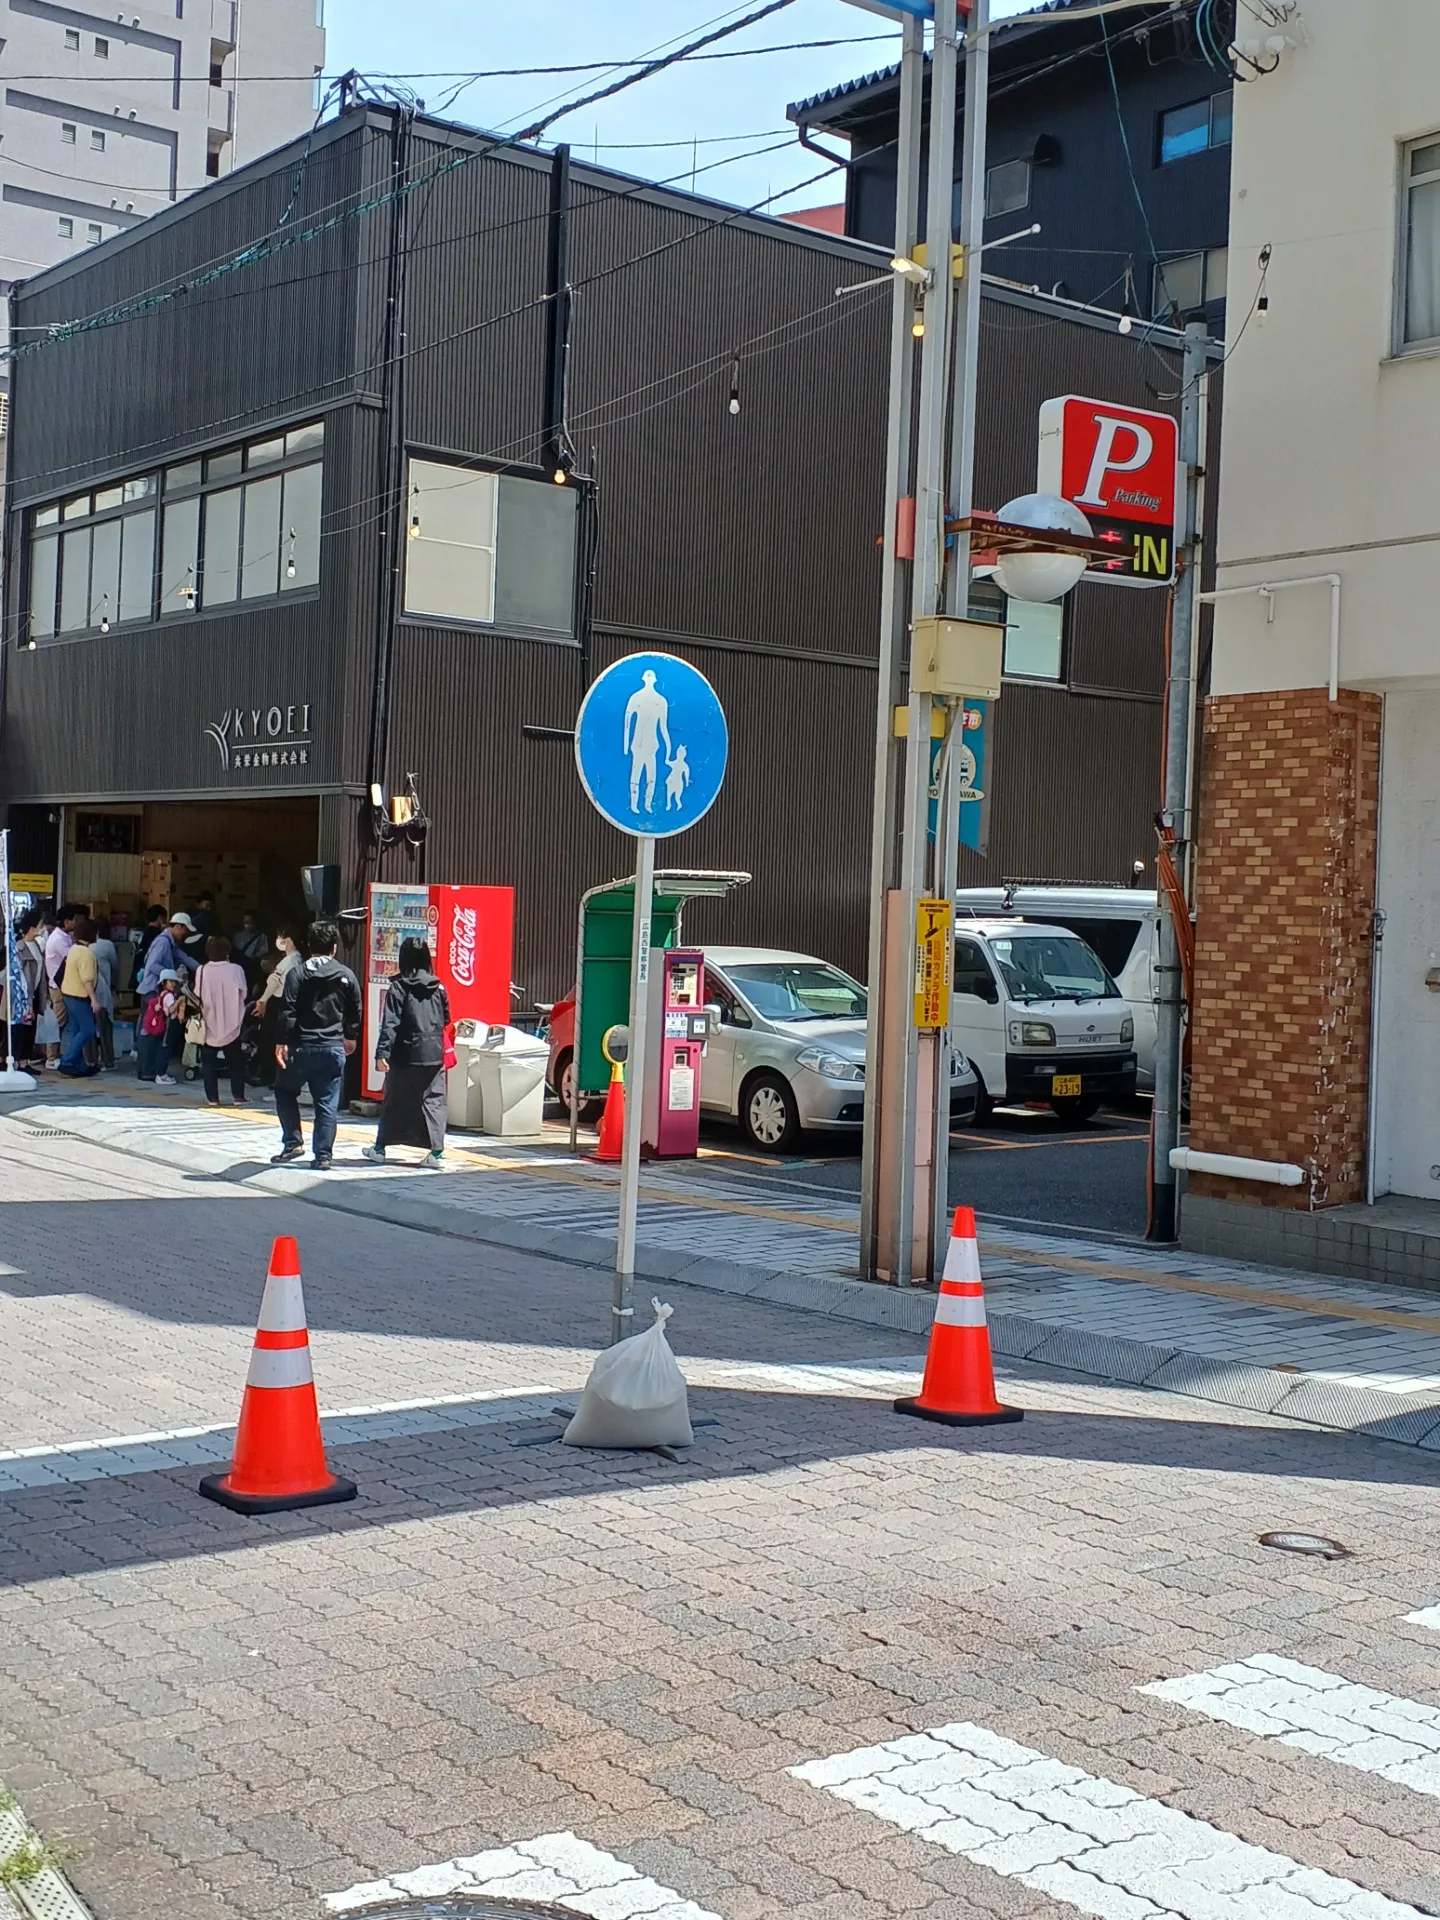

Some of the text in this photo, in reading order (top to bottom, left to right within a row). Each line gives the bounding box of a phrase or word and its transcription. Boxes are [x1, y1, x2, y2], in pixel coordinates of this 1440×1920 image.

[1072, 414, 1154, 508] P
[1114, 487, 1161, 511] Parking
[1133, 534, 1167, 575] IN
[235, 704, 310, 738] KYOEI
[234, 749, 308, 769] 共栄金物株式会社
[450, 901, 477, 987] Coca-Cola
